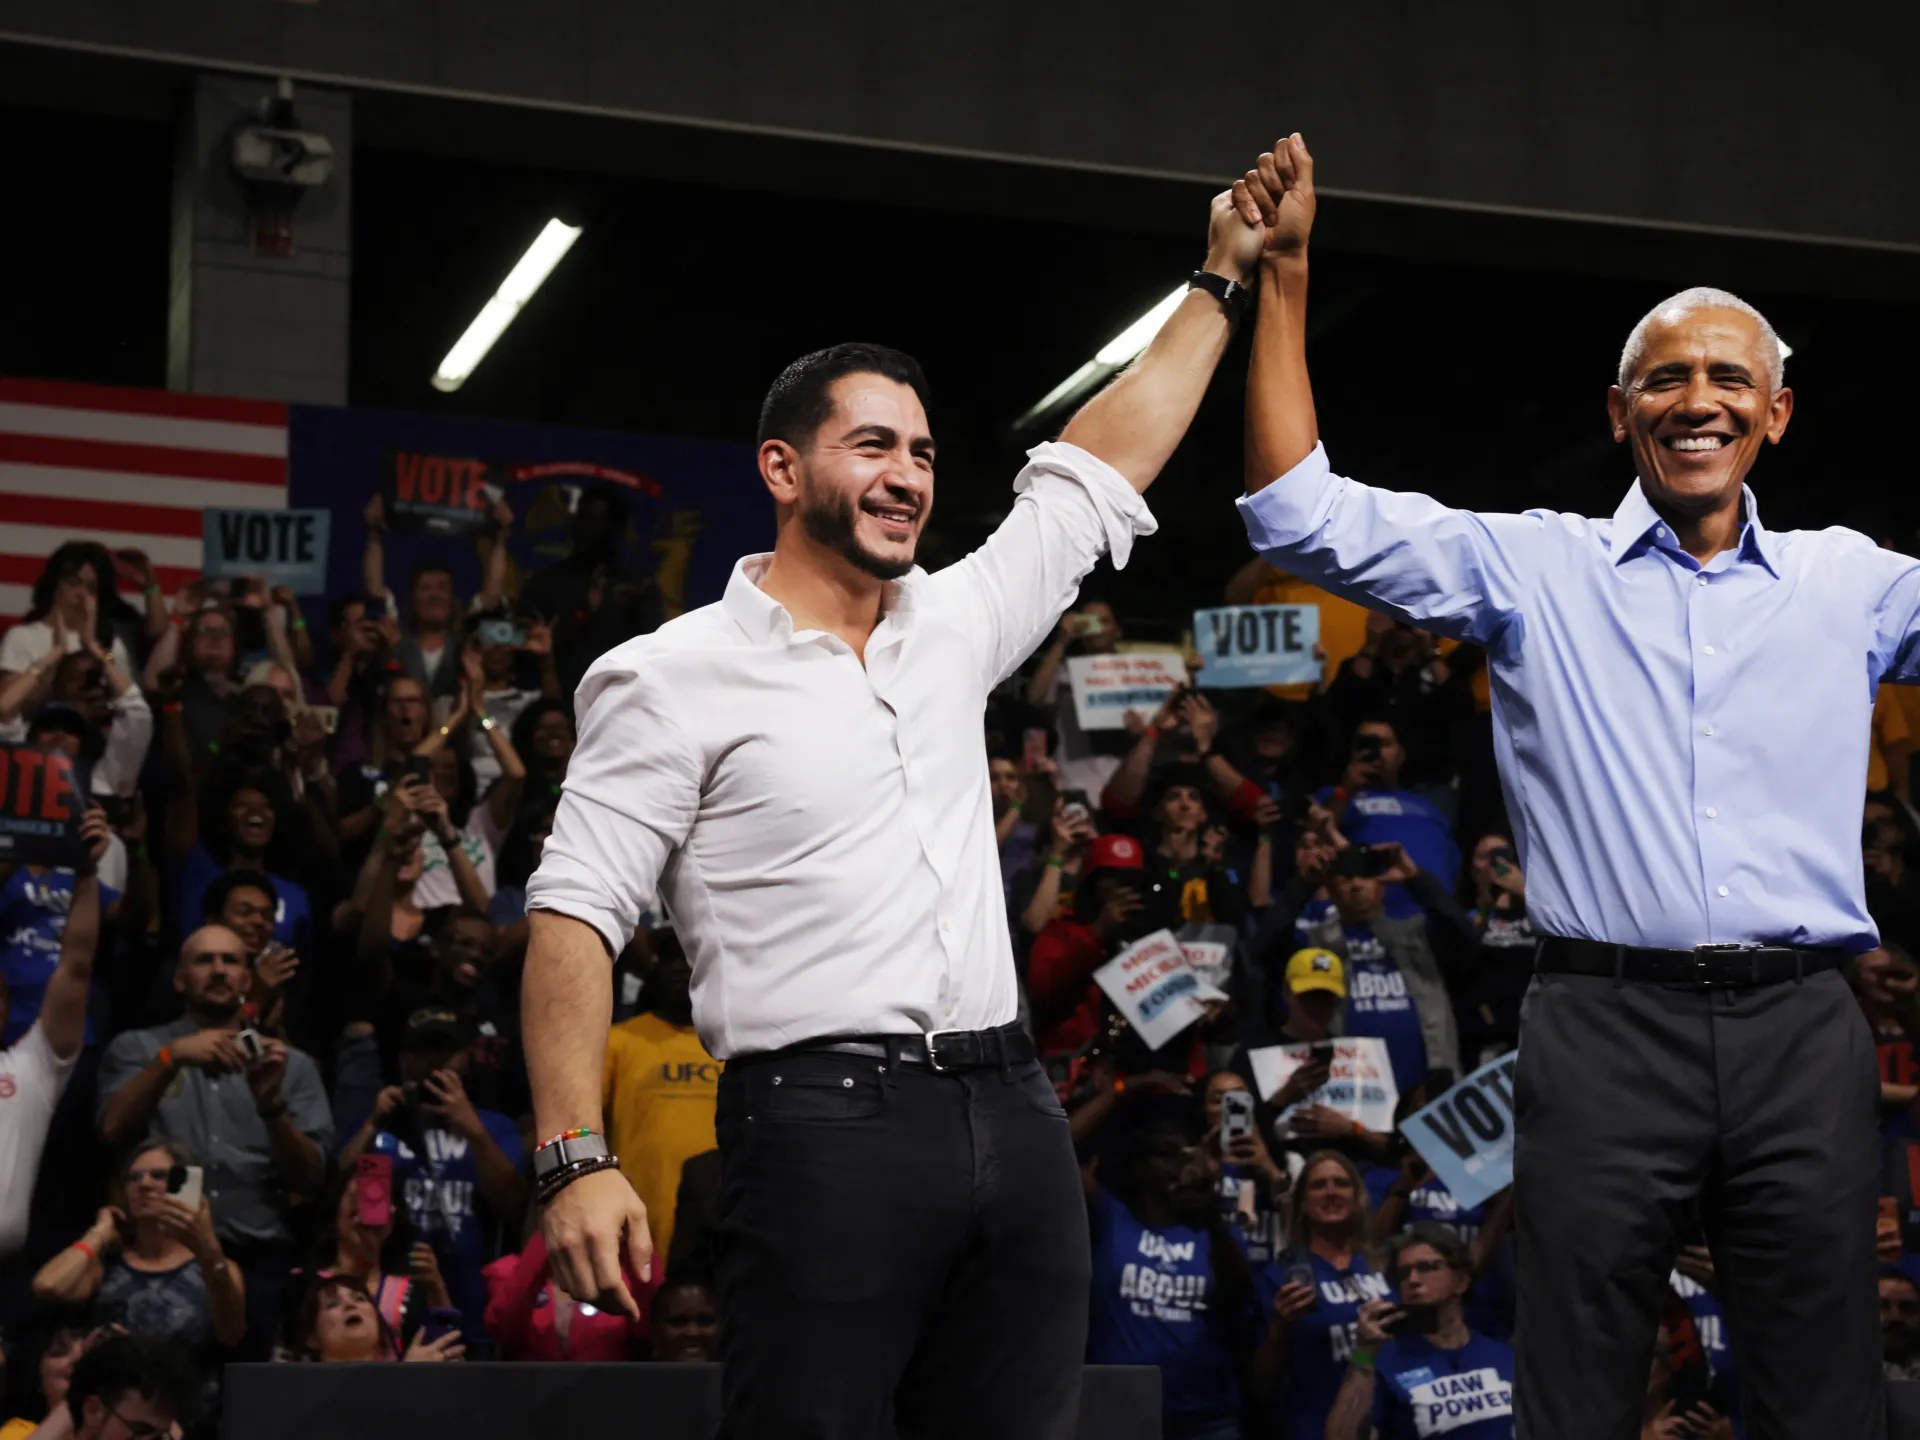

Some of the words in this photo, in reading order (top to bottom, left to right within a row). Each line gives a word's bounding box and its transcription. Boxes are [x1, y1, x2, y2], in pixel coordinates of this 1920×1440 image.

[396, 451, 488, 509] VOTE
[219, 511, 315, 562] VOTE
[1210, 608, 1303, 657] VOTE
[1138, 1229, 1196, 1263] UAW
[1320, 1271, 1392, 1304] UAW
[1431, 1374, 1484, 1398] UAW
